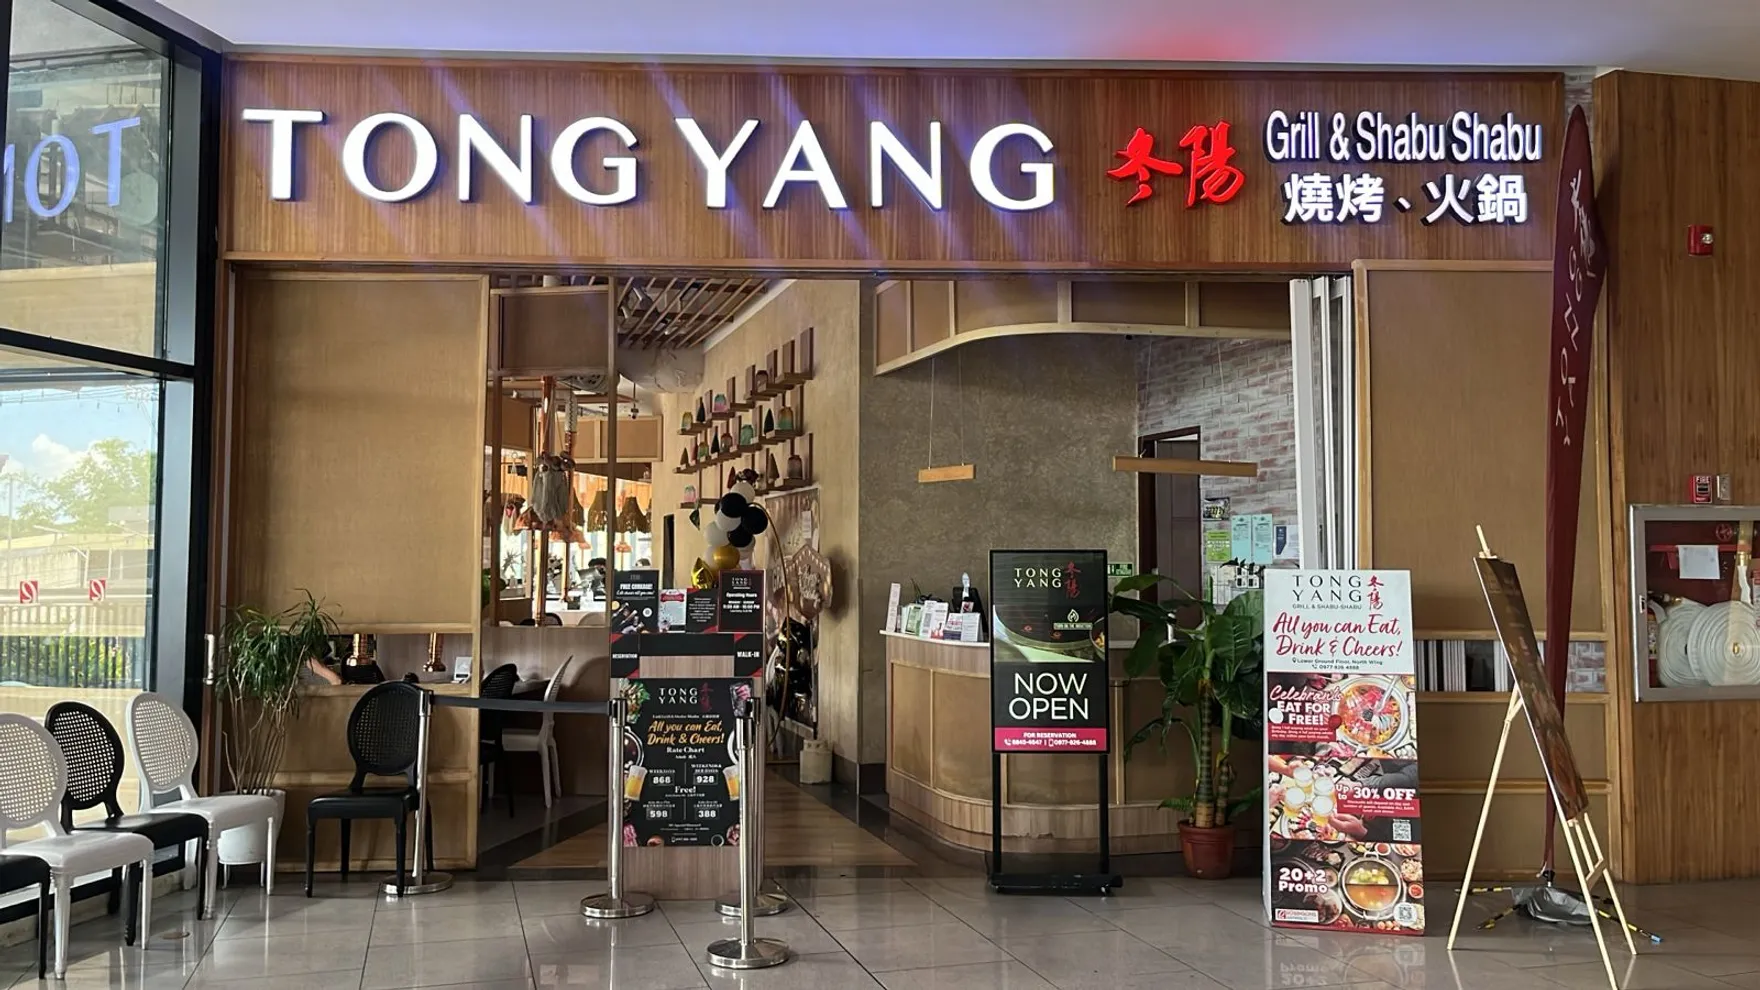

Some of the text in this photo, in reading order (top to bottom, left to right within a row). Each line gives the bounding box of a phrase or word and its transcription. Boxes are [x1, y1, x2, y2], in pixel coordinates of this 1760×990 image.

[1265, 109, 1542, 164] Grill & Shabu Shabu
[243, 108, 1056, 212] TONG YANG
[1107, 120, 1246, 208] 冬陽
[1282, 172, 1528, 225] 燒烤、火鍋
[1014, 567, 1062, 578] TONG
[1014, 578, 1062, 588] YANG
[1292, 575, 1362, 588] TONG
[1292, 589, 1362, 603] YANG
[1272, 611, 1401, 639] All you can Eat,
[1275, 634, 1326, 656] Drink
[1343, 635, 1403, 658] Cheers!
[1014, 672, 1088, 696] NOW
[658, 687, 698, 696] TONG
[658, 696, 698, 704] YANG
[1008, 697, 1090, 721] OPEN
[1277, 701, 1331, 713] EAT FOR
[1288, 713, 1325, 726] FREE!
[647, 720, 665, 732] All
[664, 723, 683, 734] you
[684, 723, 702, 732] can
[646, 732, 725, 745] Drink & Cheers!
[652, 776, 671, 784] 868
[696, 775, 715, 783] 928
[674, 785, 697, 793] Free!
[1335, 784, 1350, 794] Up
[1353, 786, 1416, 801] 30% OFF
[649, 810, 668, 818] 598
[698, 810, 717, 818] 388
[1279, 867, 1327, 883] 20+2
[1278, 880, 1328, 894] Promo
